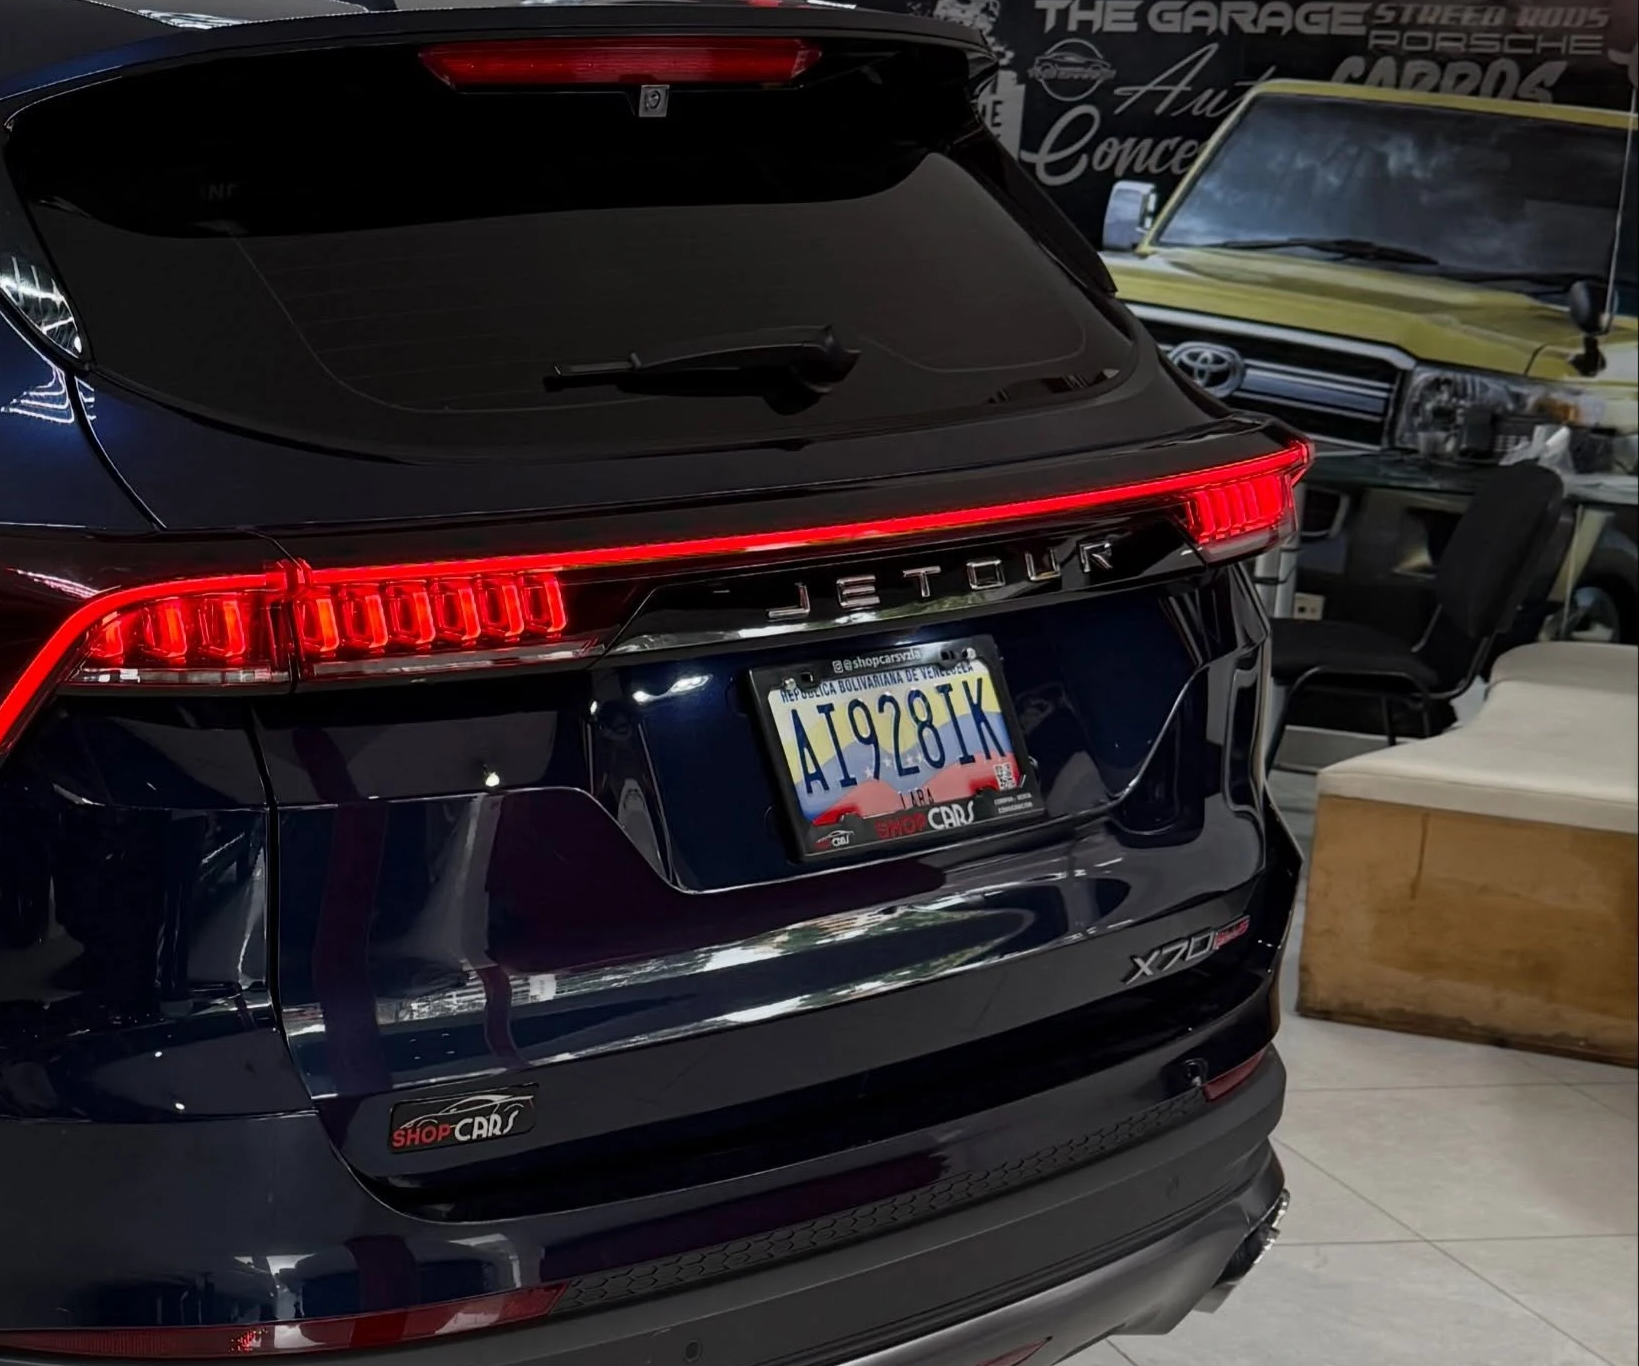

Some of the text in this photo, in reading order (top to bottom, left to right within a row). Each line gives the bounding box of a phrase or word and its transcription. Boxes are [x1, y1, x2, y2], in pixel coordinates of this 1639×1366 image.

[1147, 0, 1372, 37] GARAGE
[1368, 30, 1603, 55] PORSCHE
[1114, 42, 1276, 117] Aut
[1020, 104, 1212, 186] Conce
[766, 539, 1114, 620] JETOUR
[843, 648, 923, 672] @shopcarsvzla
[838, 670, 905, 694] BOLIVARIANA
[905, 669, 921, 684] DE
[791, 677, 1007, 795] AI928IK
[874, 800, 976, 841] SHOP CARS
[1125, 929, 1215, 985] X70
[392, 1109, 519, 1148] SHOP CARS
